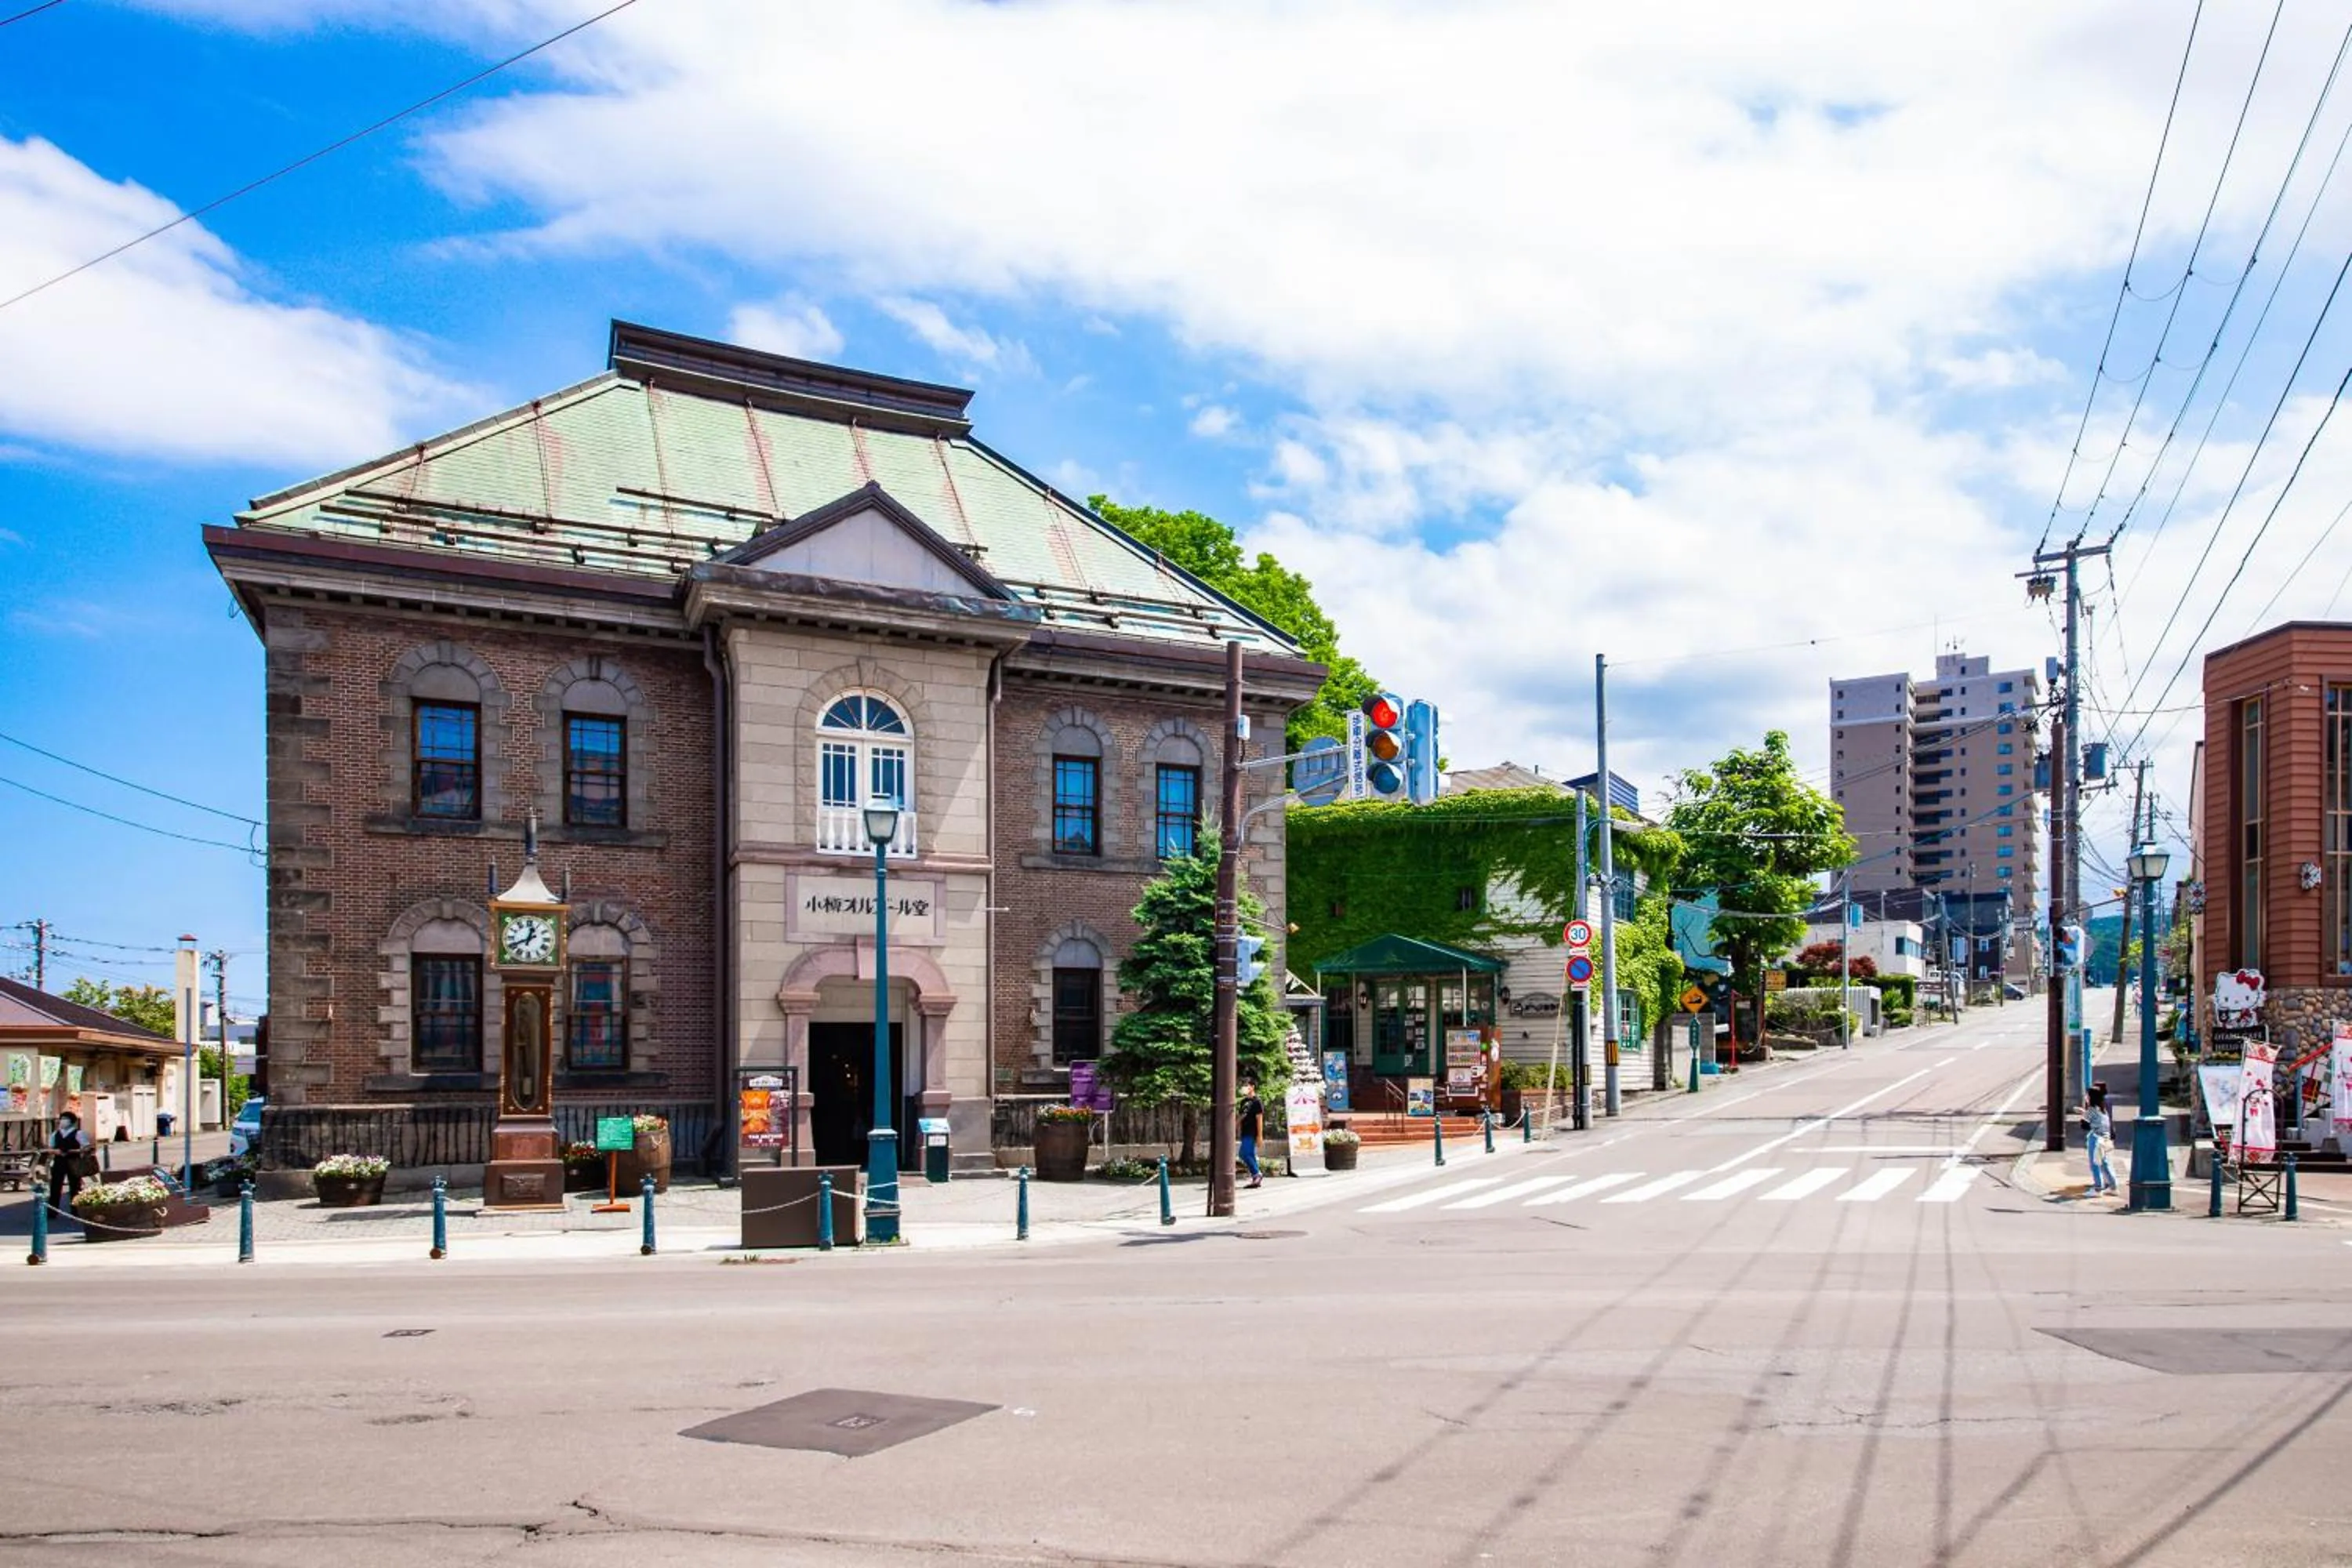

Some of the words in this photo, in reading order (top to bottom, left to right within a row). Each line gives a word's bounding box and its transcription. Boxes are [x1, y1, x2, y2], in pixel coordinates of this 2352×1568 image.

[805, 895, 929, 916] 小樽オルール堂
[1570, 927, 1586, 940] 30
